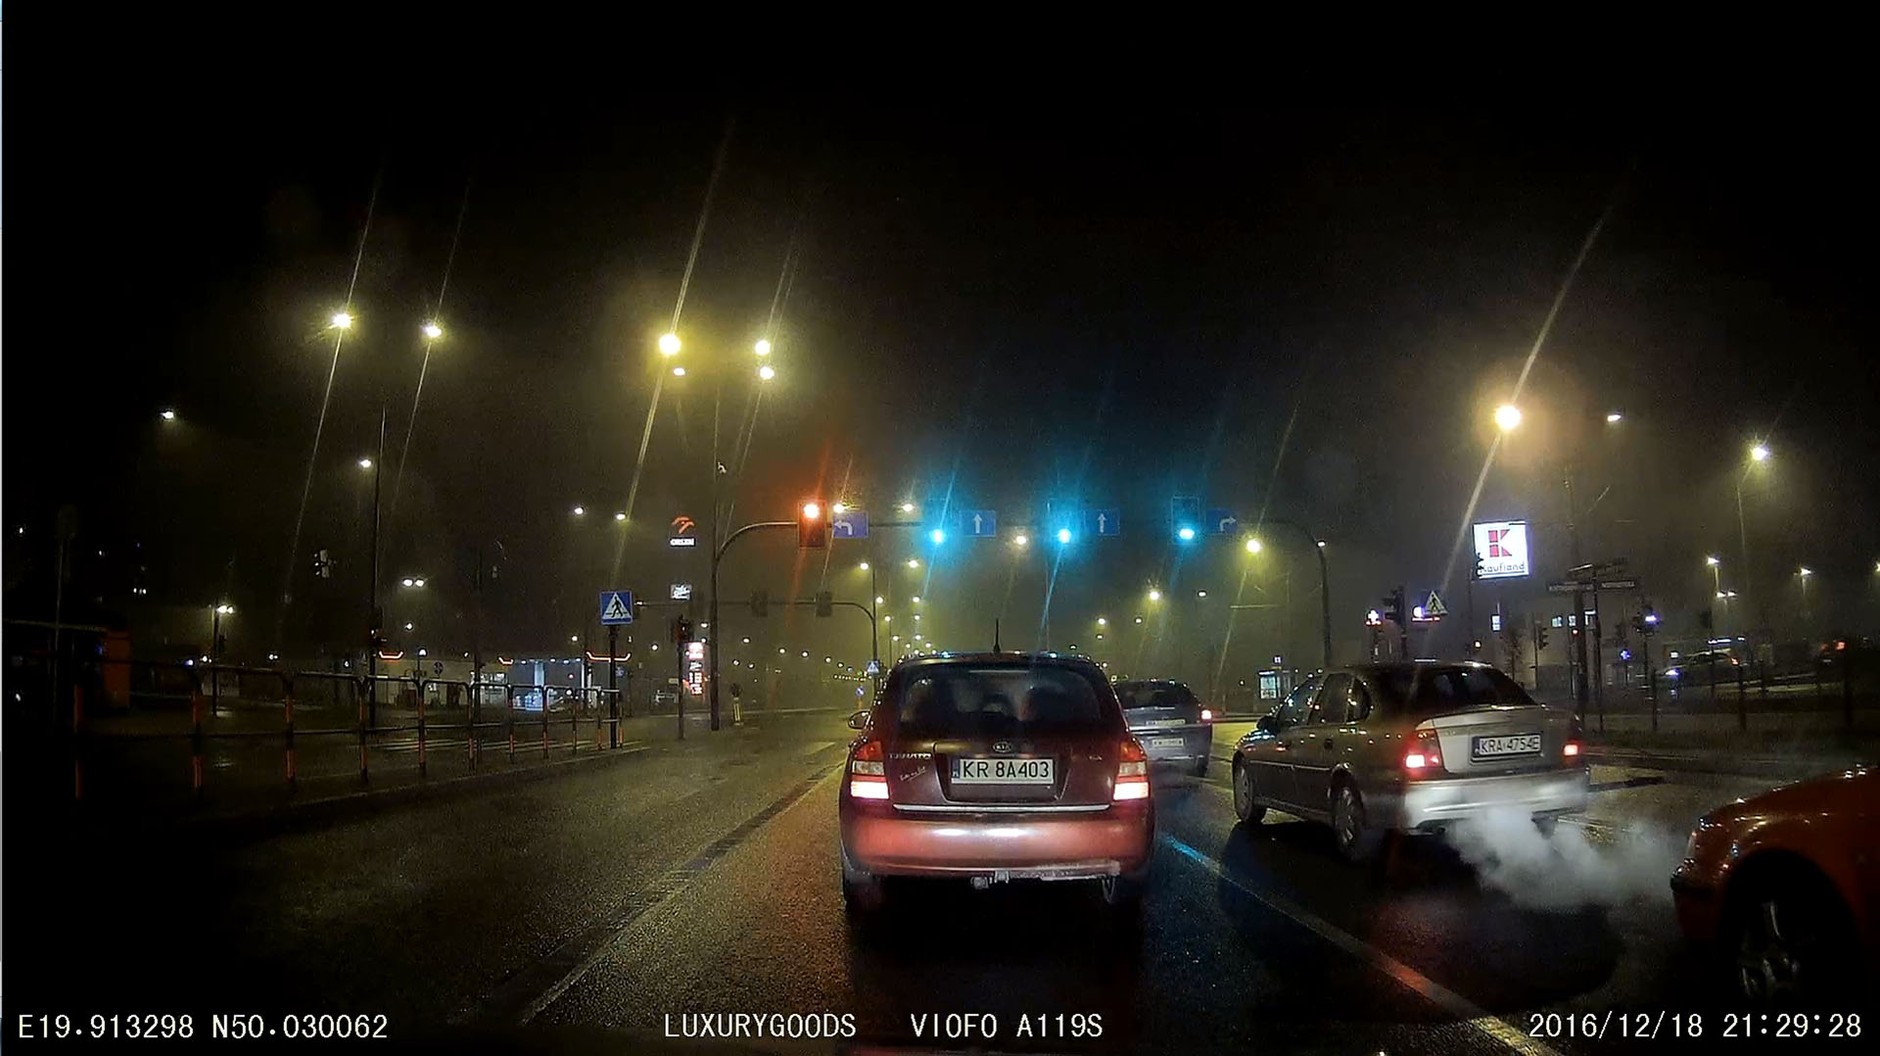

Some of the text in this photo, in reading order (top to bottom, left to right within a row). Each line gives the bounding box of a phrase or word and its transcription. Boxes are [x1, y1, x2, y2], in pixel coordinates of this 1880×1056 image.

[1488, 529, 1512, 557] K
[1481, 739, 1503, 753] KRA
[963, 761, 1049, 778] KR 8A403
